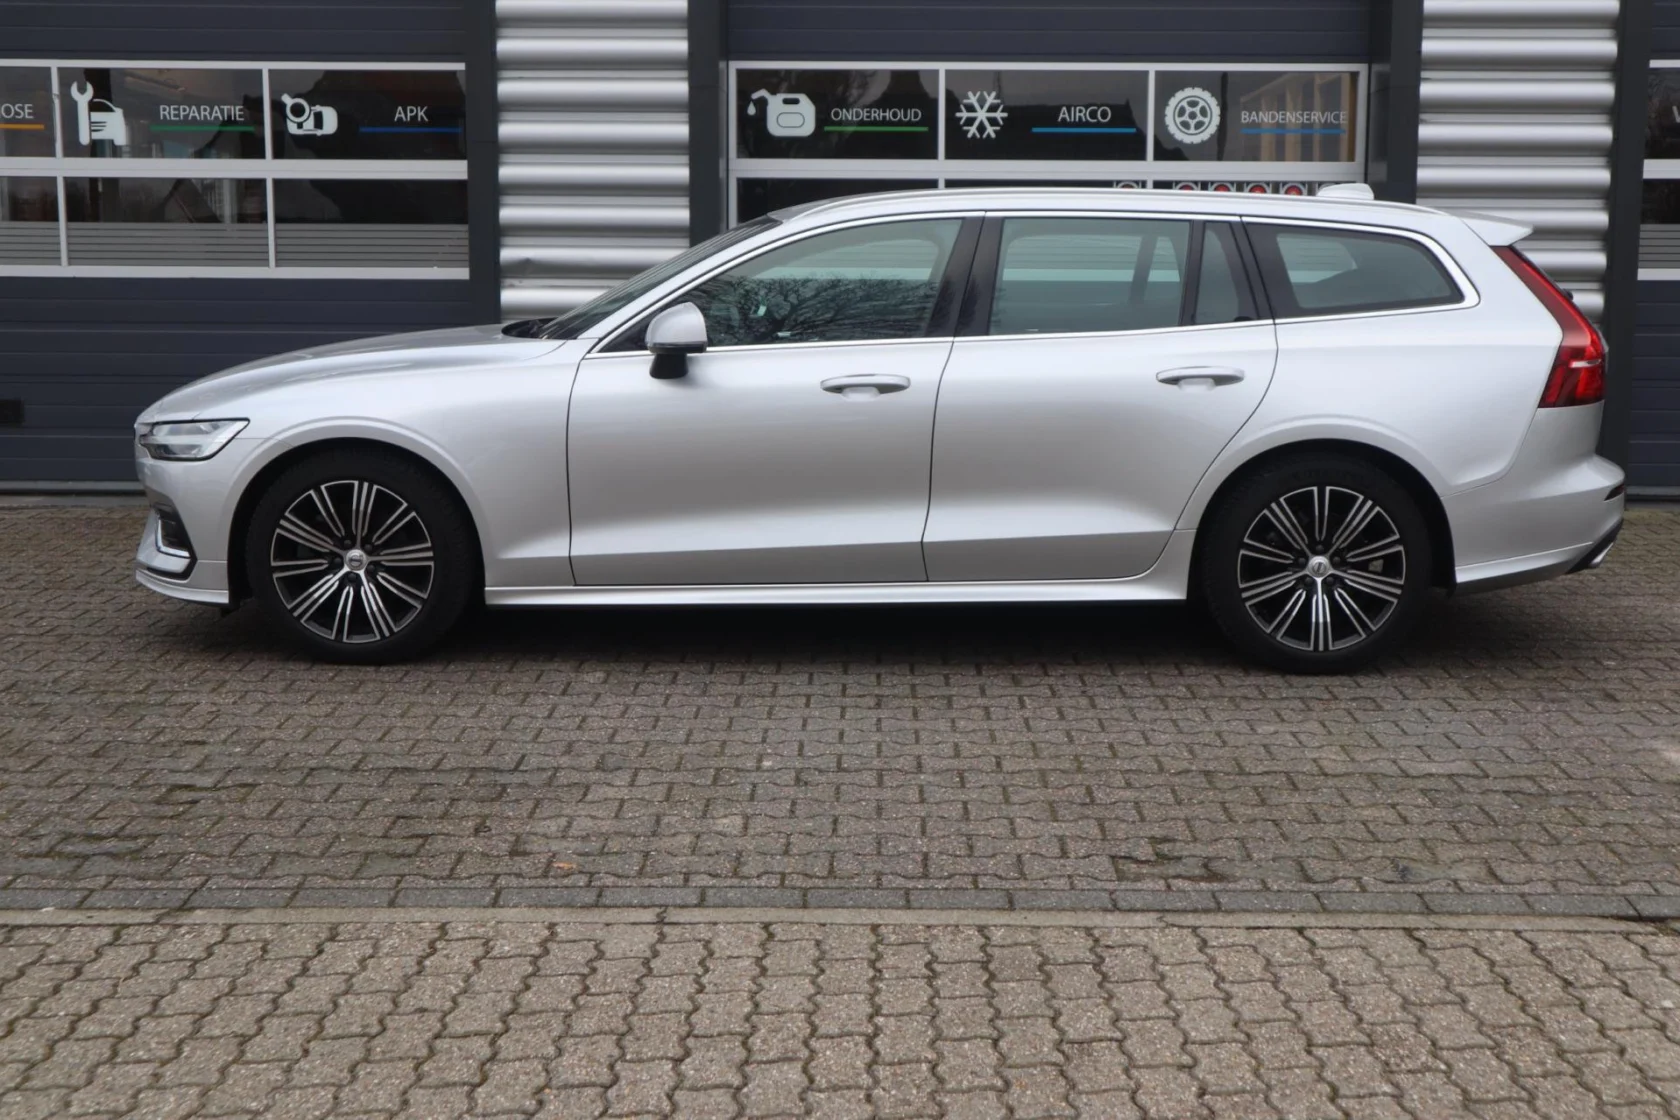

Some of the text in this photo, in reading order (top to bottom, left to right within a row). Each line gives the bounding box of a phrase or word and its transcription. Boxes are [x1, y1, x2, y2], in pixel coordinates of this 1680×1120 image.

[159, 104, 245, 121] REPARATIE
[394, 105, 429, 122] APK
[830, 107, 922, 121] ONDERHOUD
[1057, 105, 1112, 123] AIRCO
[1241, 110, 1347, 124] BANDENSERVICE
